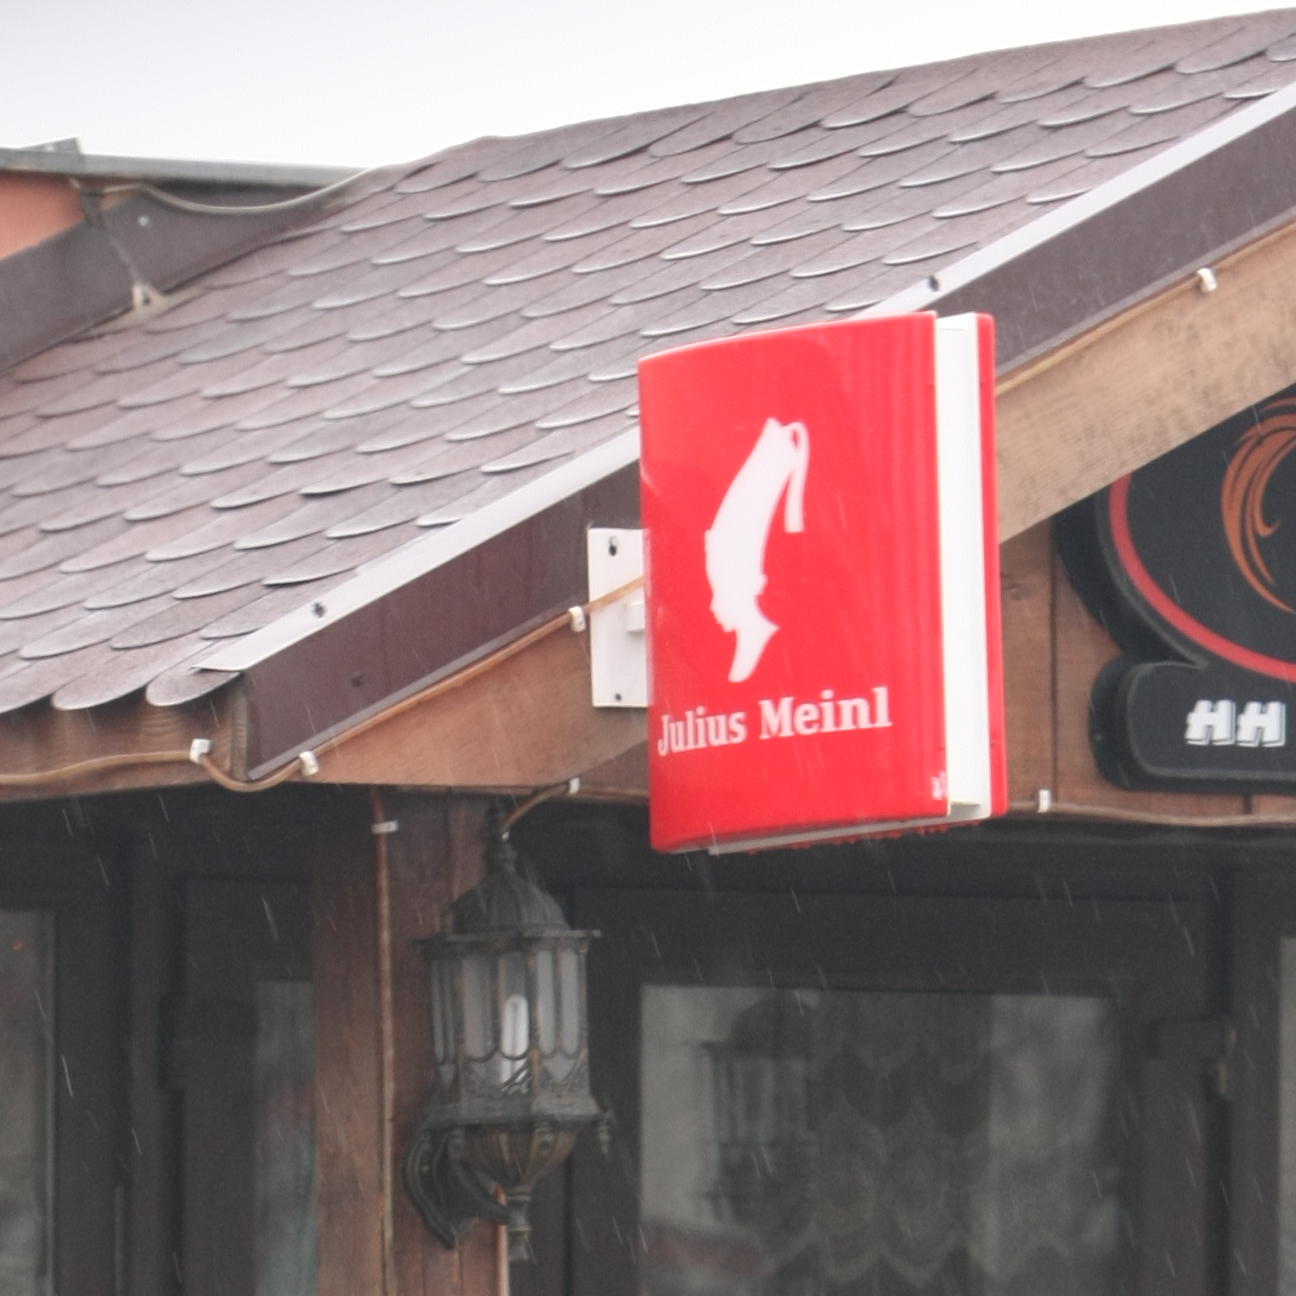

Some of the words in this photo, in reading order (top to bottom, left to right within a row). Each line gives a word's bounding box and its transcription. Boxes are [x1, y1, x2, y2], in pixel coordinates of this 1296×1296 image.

[657, 705, 747, 757] Julius
[759, 686, 893, 741] Meinl
[1185, 699, 1286, 747] HH
